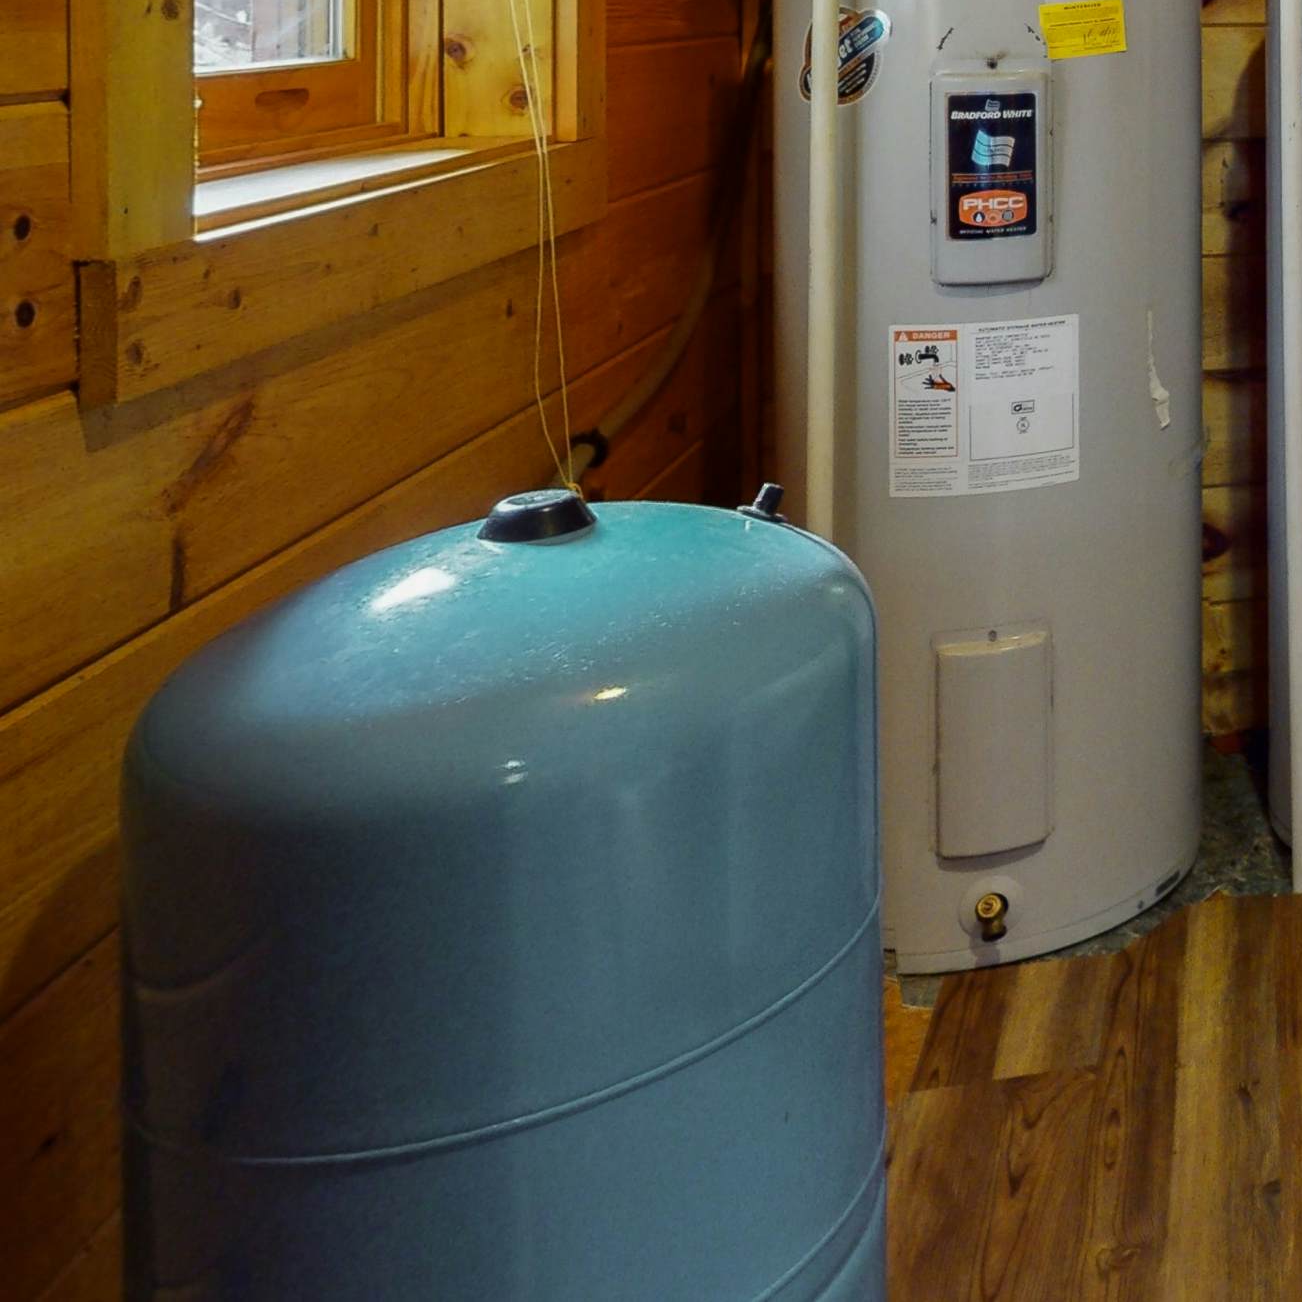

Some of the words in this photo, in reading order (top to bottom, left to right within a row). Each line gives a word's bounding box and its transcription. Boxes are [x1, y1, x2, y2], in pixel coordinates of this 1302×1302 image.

[950, 110, 1001, 120] BRADFORD
[1002, 109, 1033, 119] WHITE
[963, 196, 1024, 211] PHCC
[912, 330, 951, 340] DANGER
